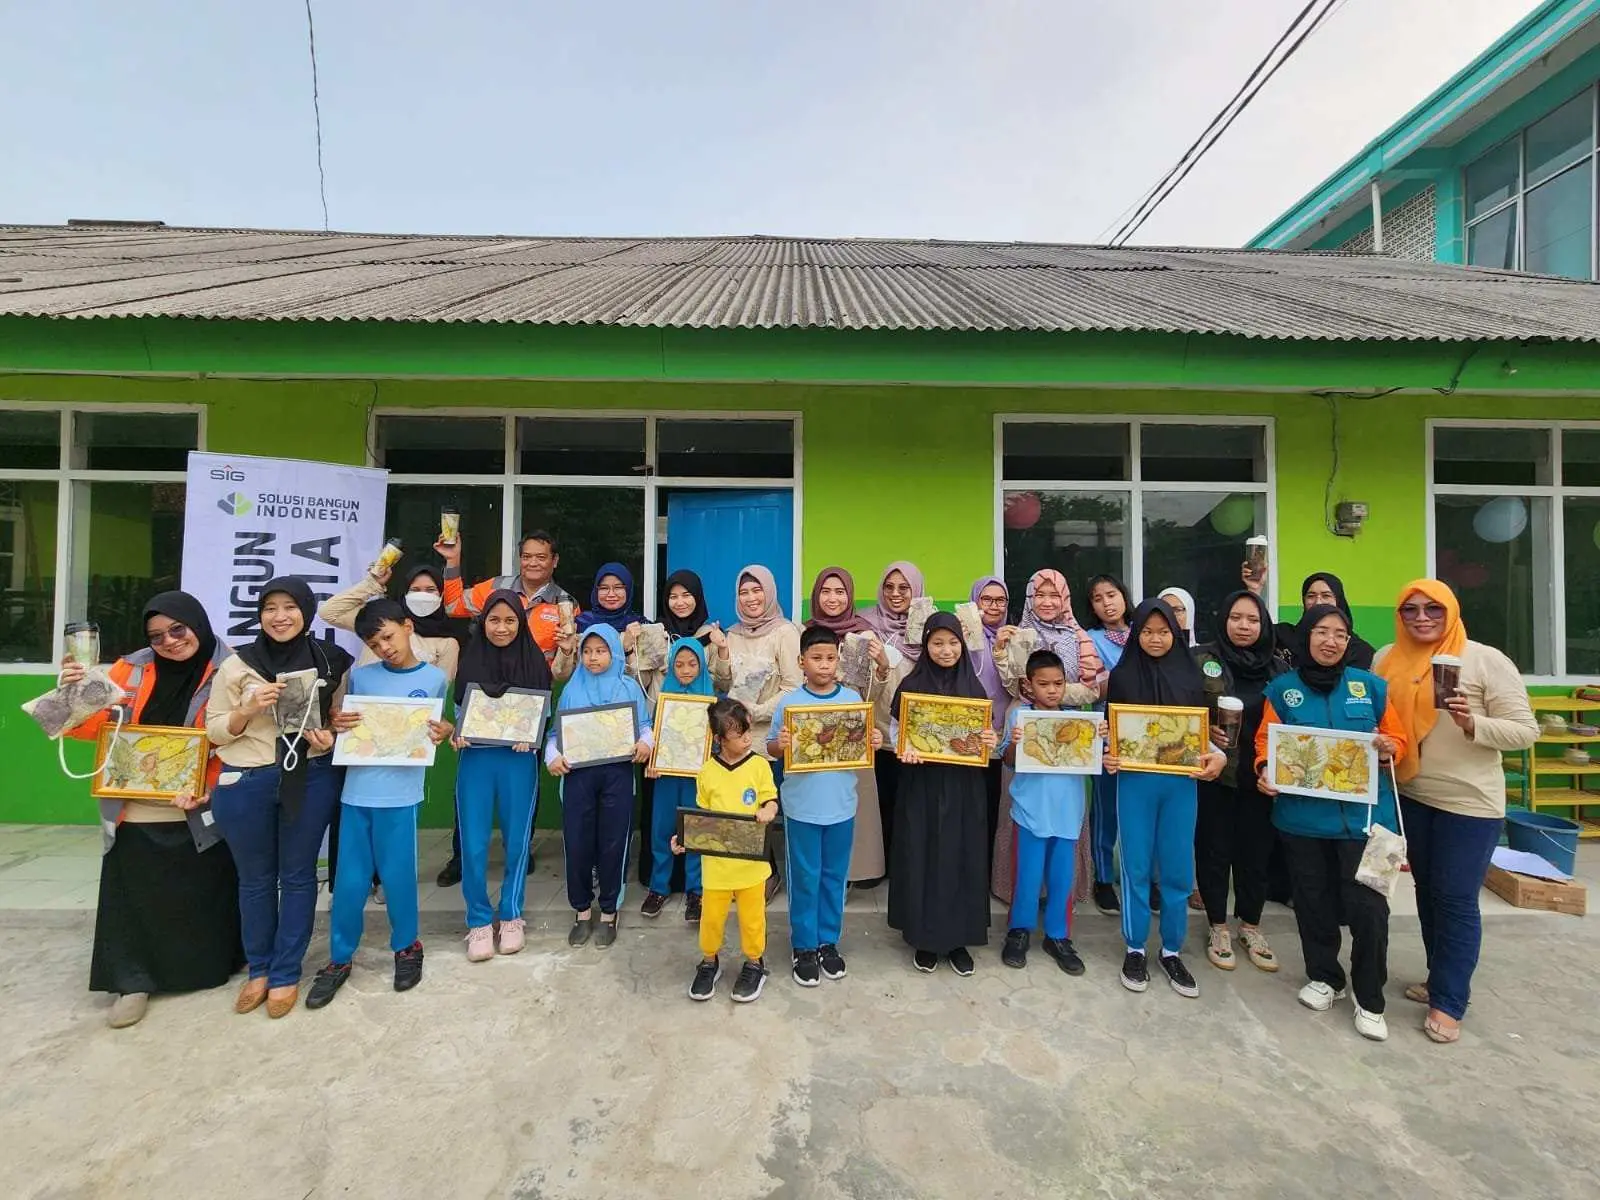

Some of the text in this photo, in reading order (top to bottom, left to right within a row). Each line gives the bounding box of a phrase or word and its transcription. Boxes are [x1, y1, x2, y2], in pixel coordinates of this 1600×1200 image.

[210, 465, 245, 482] SIG
[258, 493, 360, 511] SOLUSI BANGUN
[256, 505, 359, 523] INDONESIA
